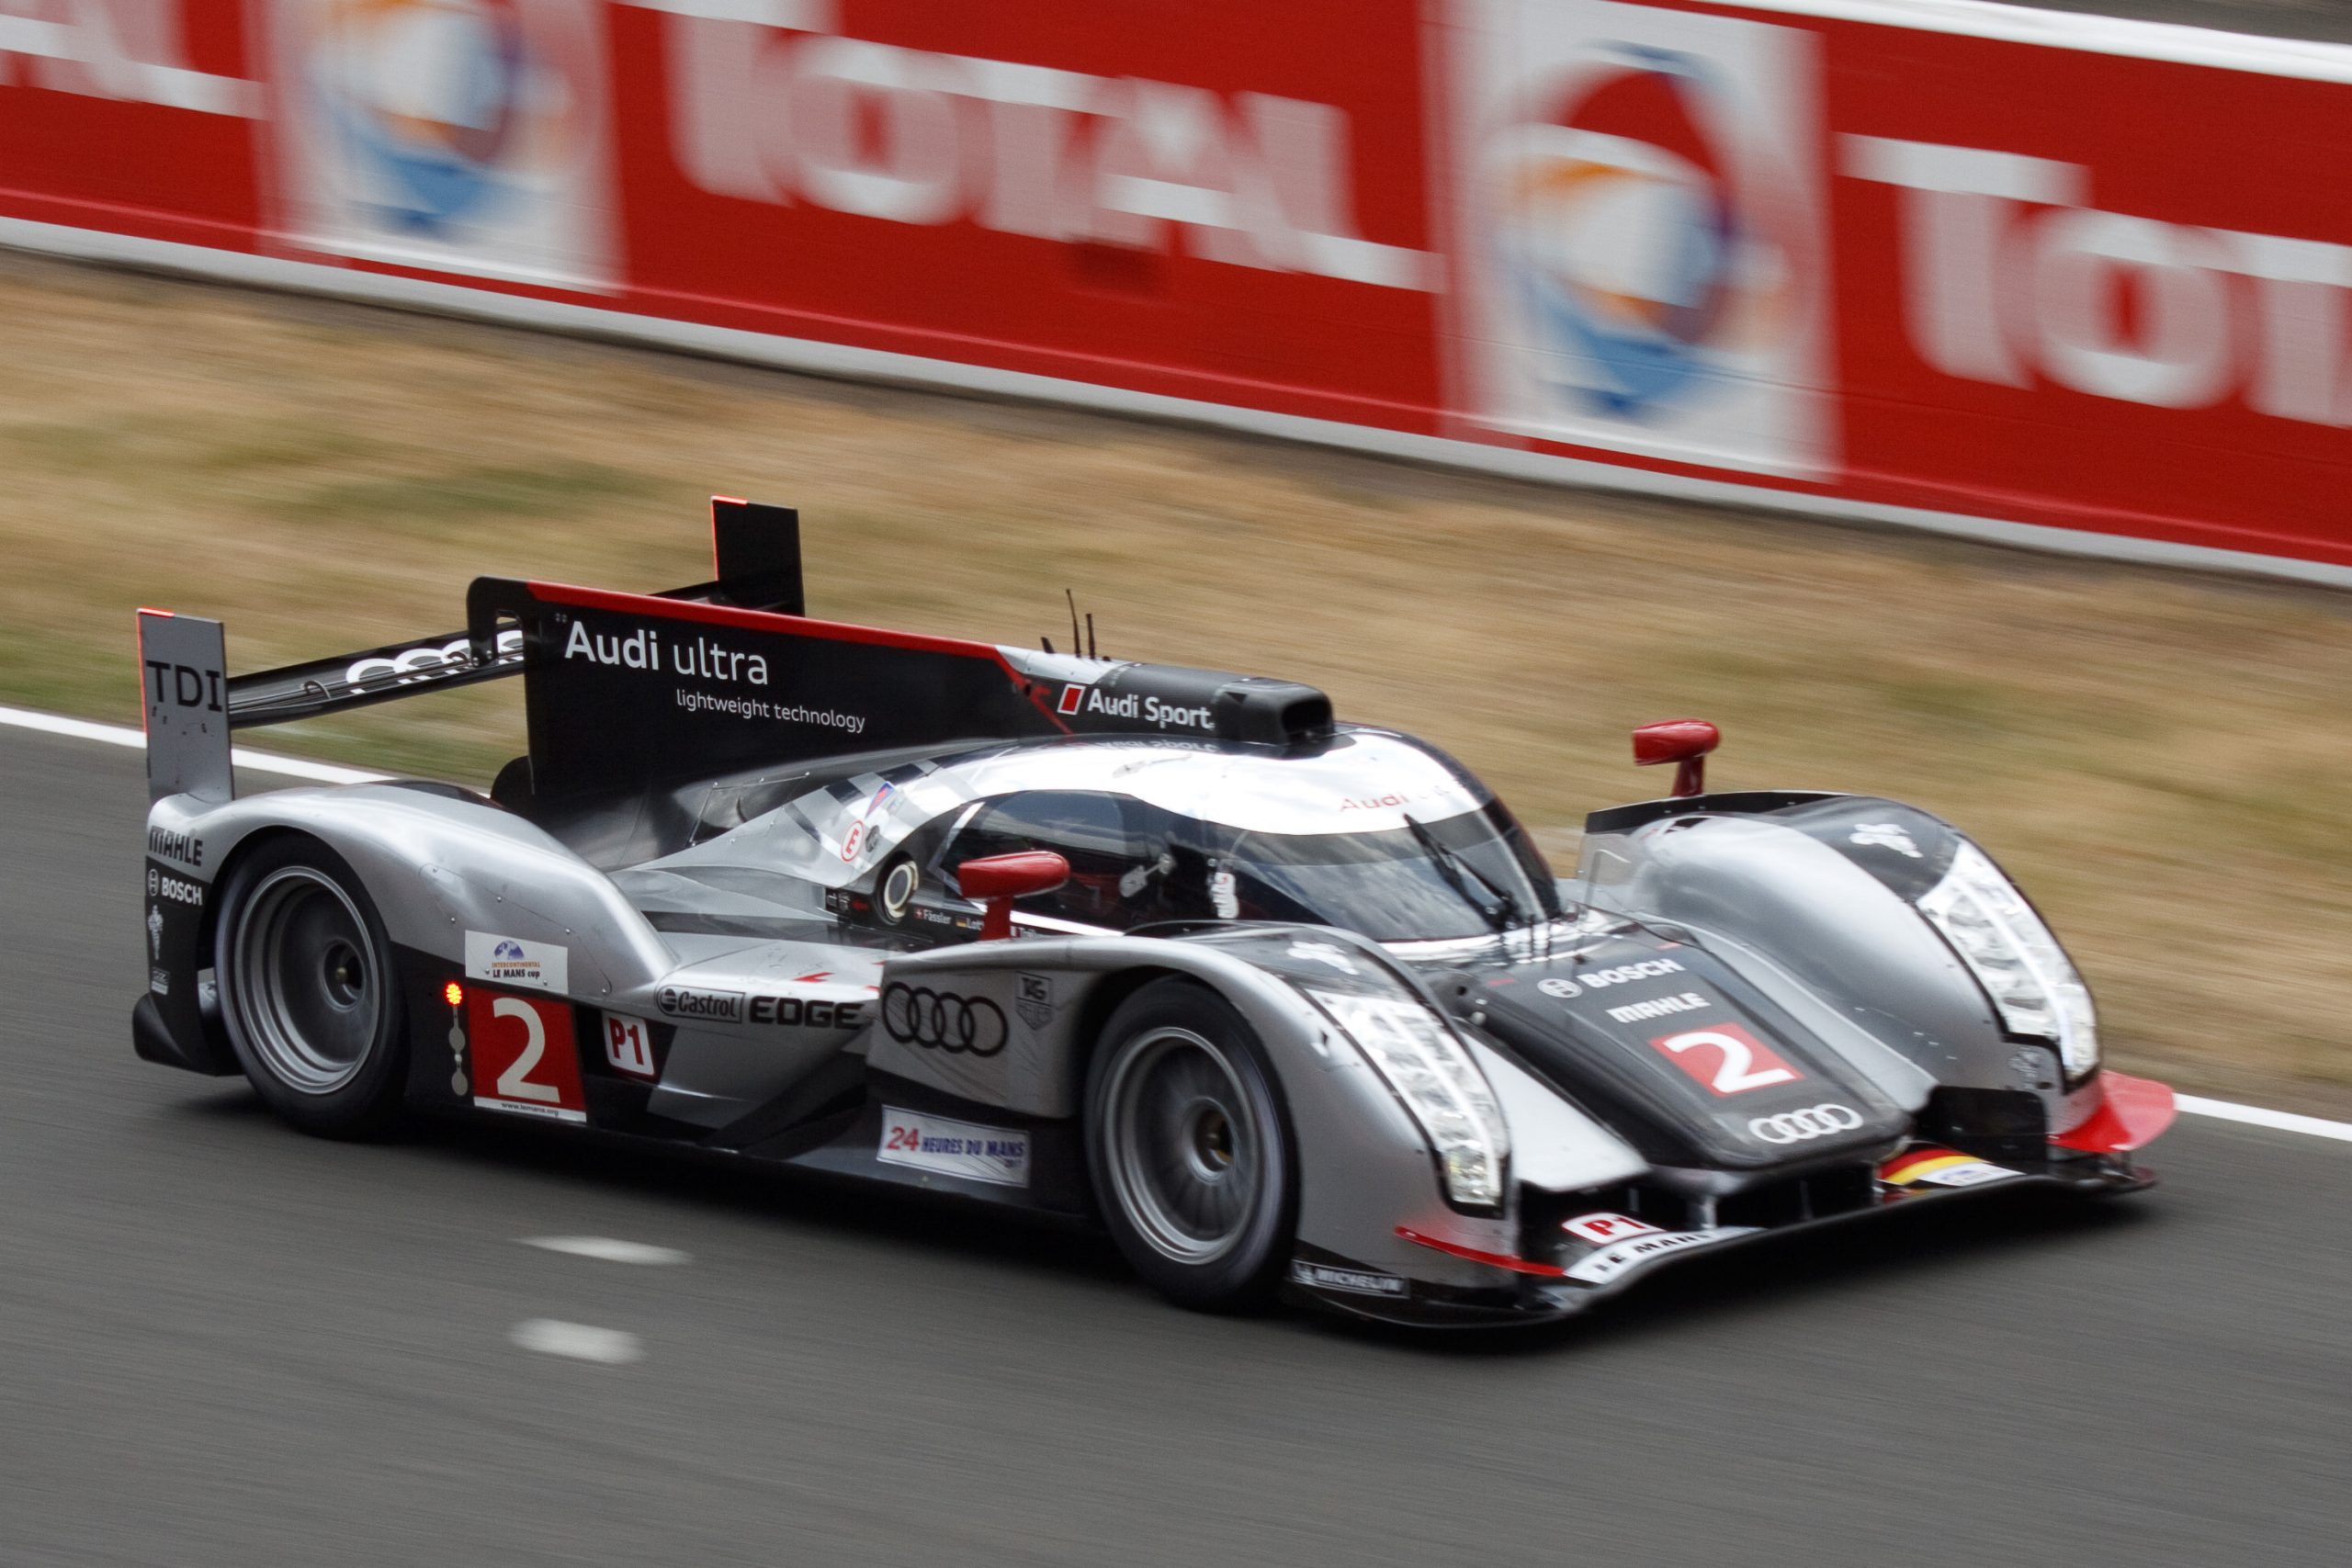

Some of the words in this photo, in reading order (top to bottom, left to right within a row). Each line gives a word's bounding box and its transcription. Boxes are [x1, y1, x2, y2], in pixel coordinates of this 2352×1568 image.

[608, 0, 1447, 293] TOTAL
[565, 620, 660, 671] Audi
[673, 637, 769, 685] ultra
[145, 660, 223, 713] TDI
[676, 688, 770, 720] lightweight
[774, 705, 866, 734] technology
[1087, 688, 1139, 718] Audi
[1144, 696, 1216, 730] Sport
[148, 826, 204, 867] MAHLE
[161, 876, 203, 907] BOSCH
[503, 968, 526, 978] MANS
[527, 970, 540, 980] cup
[1577, 958, 1687, 988] BOSCH
[677, 990, 736, 1018] Castrol
[750, 995, 865, 1030] EDGE
[1605, 992, 1712, 1023] MAHLE
[492, 997, 560, 1104] 2
[608, 1017, 645, 1066] P1
[1662, 1032, 1797, 1093] 2
[887, 1126, 919, 1152] 24
[1582, 1215, 1646, 1236] P1
